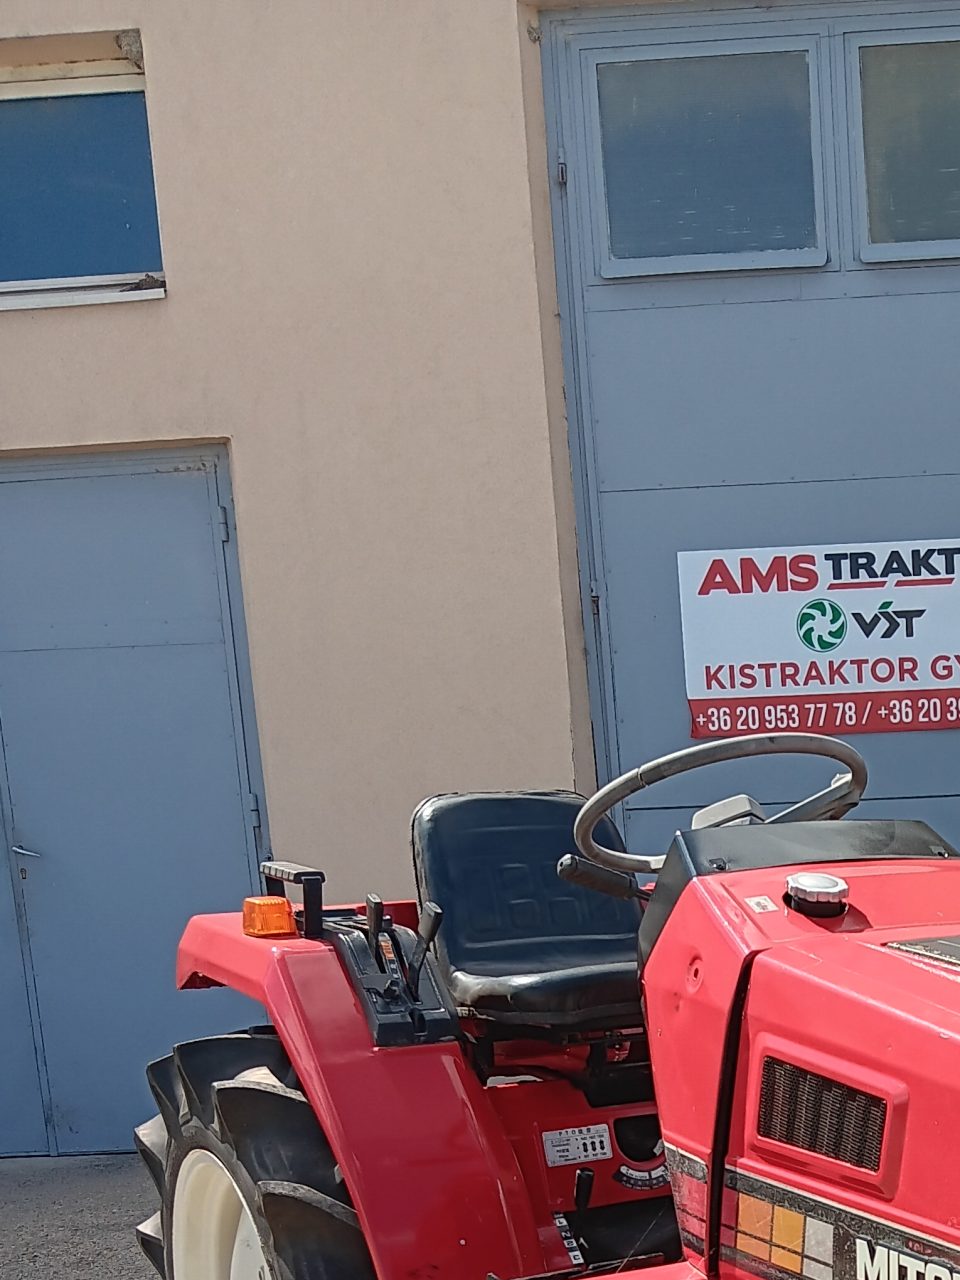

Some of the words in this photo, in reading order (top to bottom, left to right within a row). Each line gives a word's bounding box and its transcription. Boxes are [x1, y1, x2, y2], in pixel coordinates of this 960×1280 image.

[698, 554, 819, 595] AMS
[705, 657, 918, 690] KISTRAKTOR
[696, 707, 731, 730] +36
[736, 706, 759, 729] 20
[765, 704, 799, 729] 953
[805, 704, 827, 726] 77
[833, 702, 855, 726] 78
[878, 700, 912, 723] +36
[918, 698, 941, 722] 20
